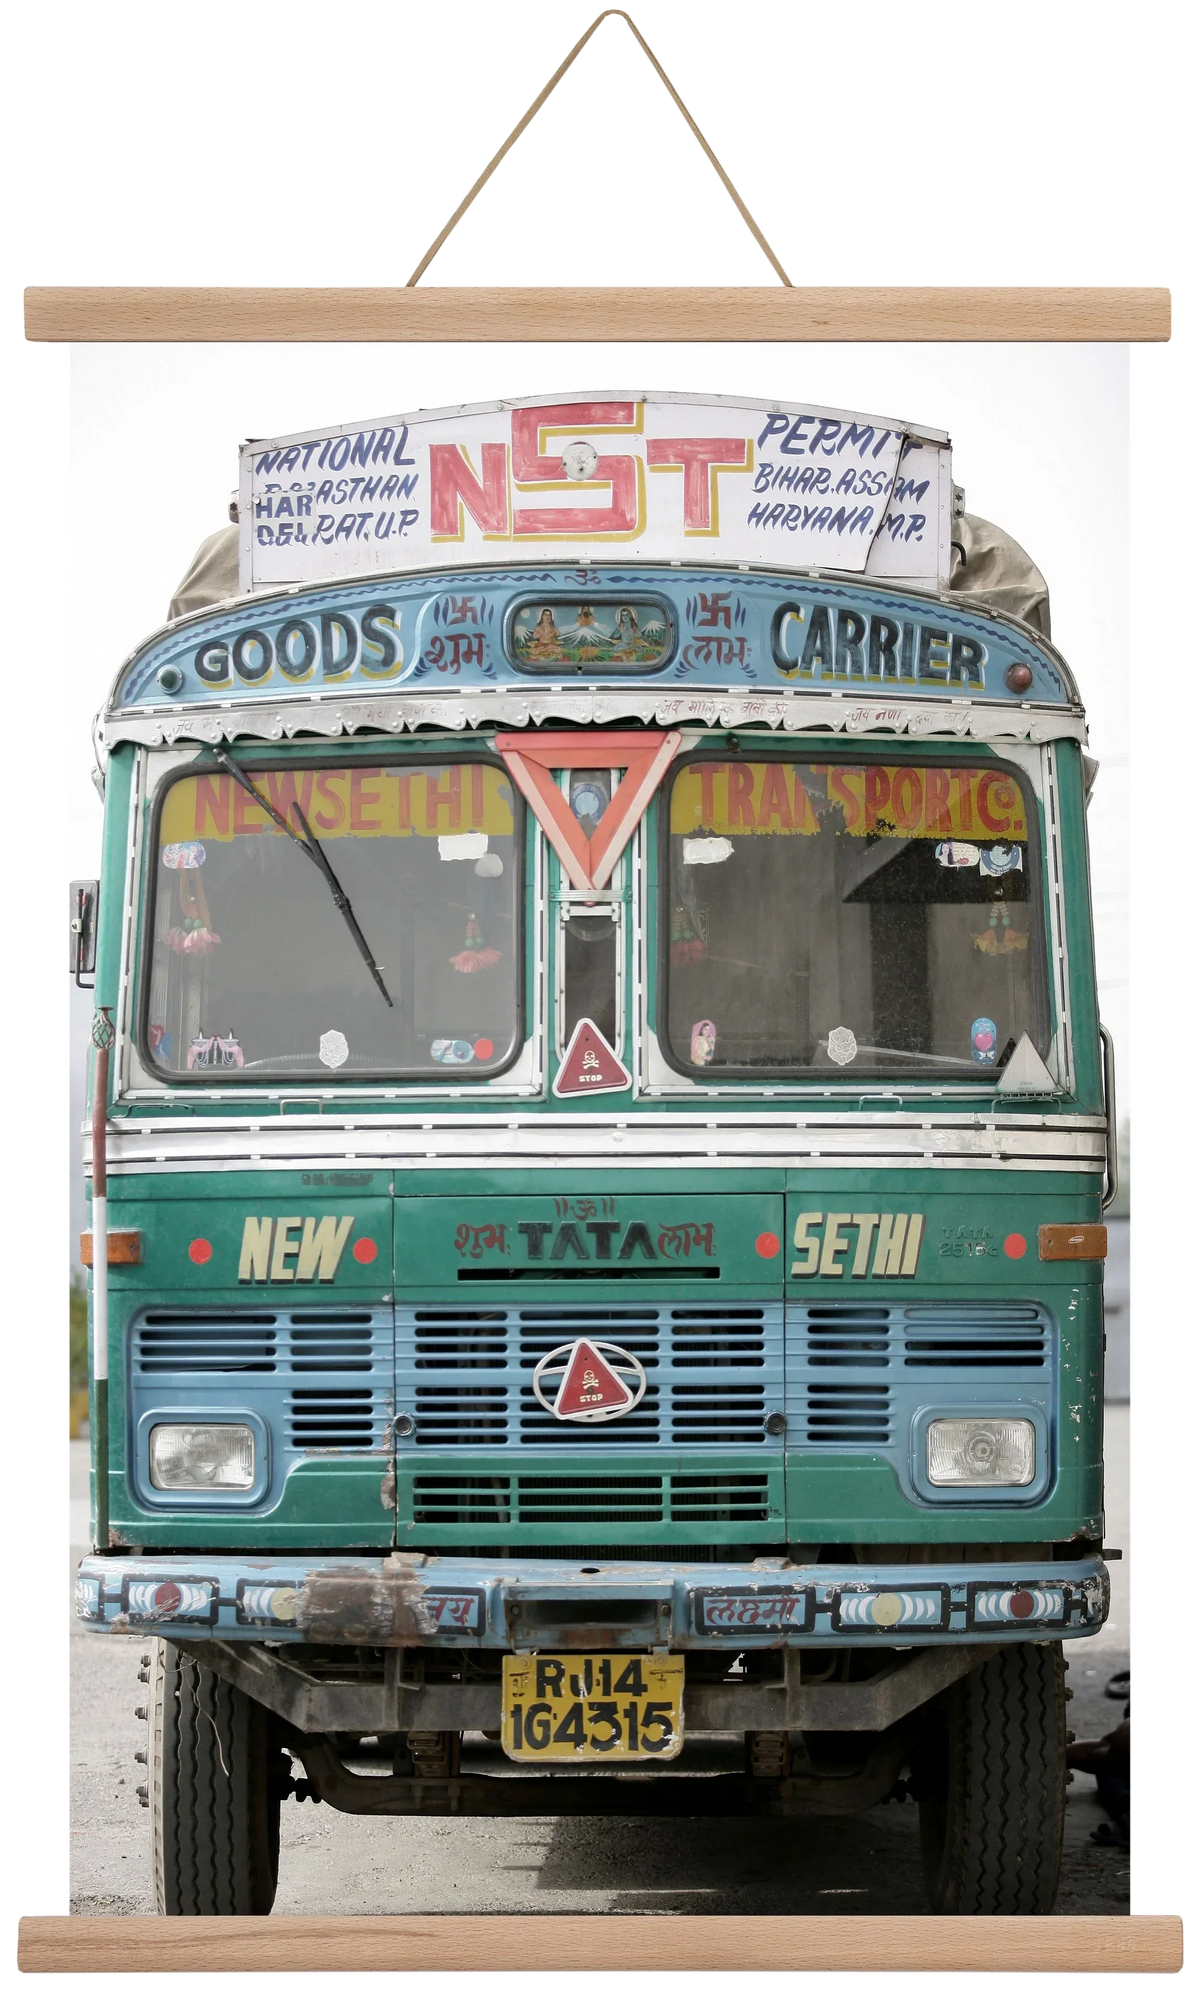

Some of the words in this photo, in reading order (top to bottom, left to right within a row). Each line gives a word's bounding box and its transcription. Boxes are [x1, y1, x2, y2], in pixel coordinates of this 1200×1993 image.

[255, 425, 417, 476] NATIONAL
[757, 413, 924, 462] PERMIT
[429, 402, 753, 543] NST
[256, 495, 314, 519] HAR
[194, 603, 404, 690] GOODS
[771, 600, 988, 692] CARRIER
[579, 1074, 603, 1082] STOP
[238, 1215, 356, 1285] NEW
[517, 1221, 658, 1260] TATA
[791, 1212, 926, 1280] SETHI
[942, 1224, 993, 1239] TATA
[580, 1394, 603, 1403] STOP
